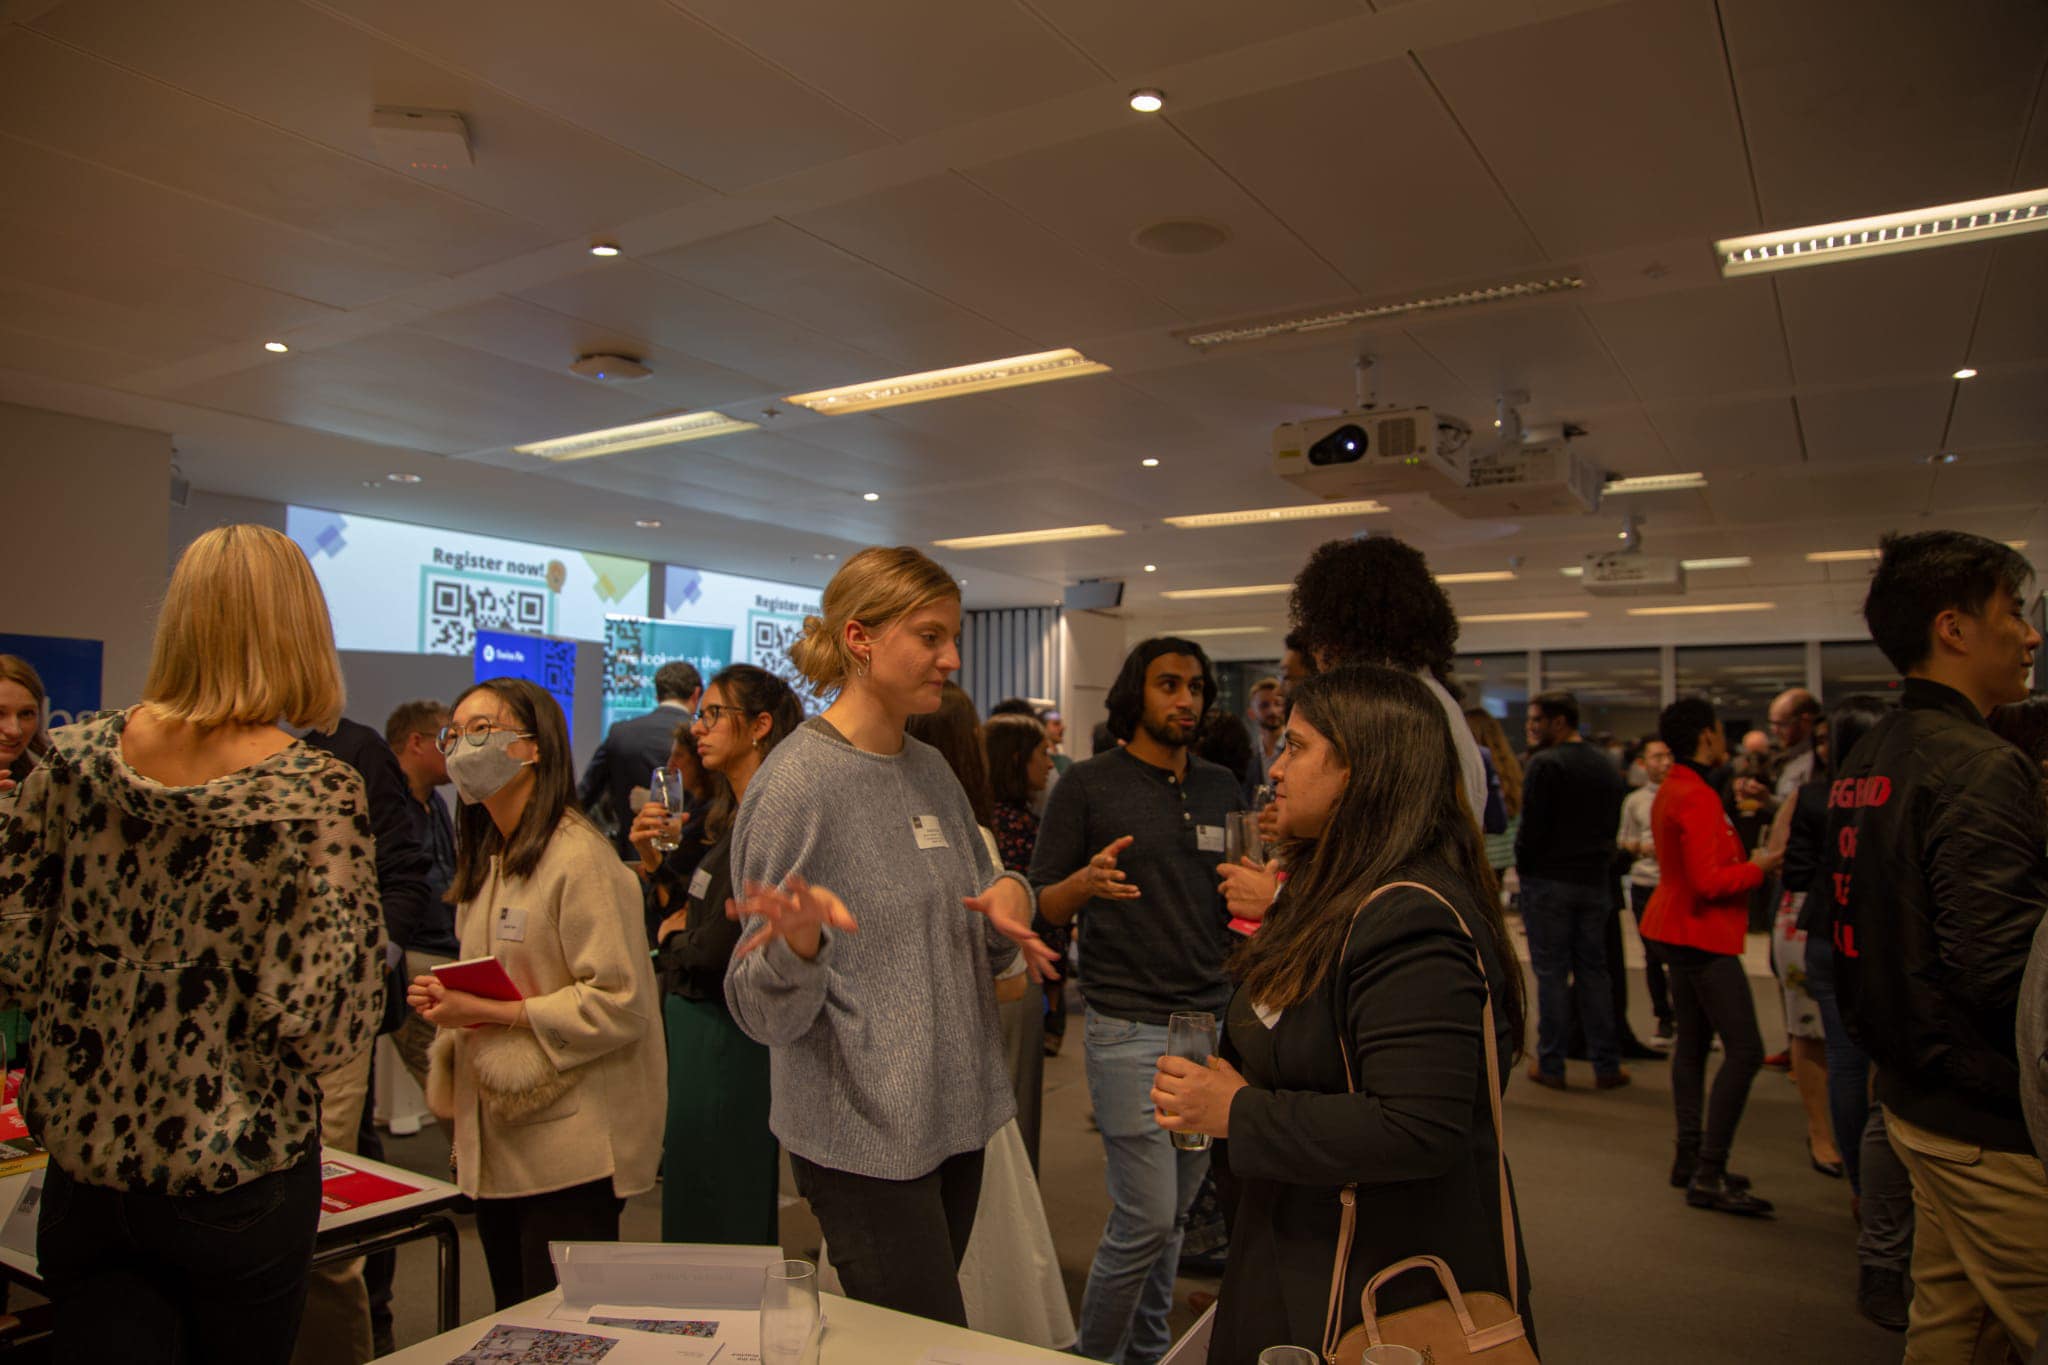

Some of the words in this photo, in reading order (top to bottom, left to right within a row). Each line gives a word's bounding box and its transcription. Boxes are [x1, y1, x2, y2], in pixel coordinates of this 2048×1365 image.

[433, 547, 503, 572] Register
[507, 559, 545, 577] now!
[756, 594, 799, 613] Register
[701, 655, 723, 668] the
